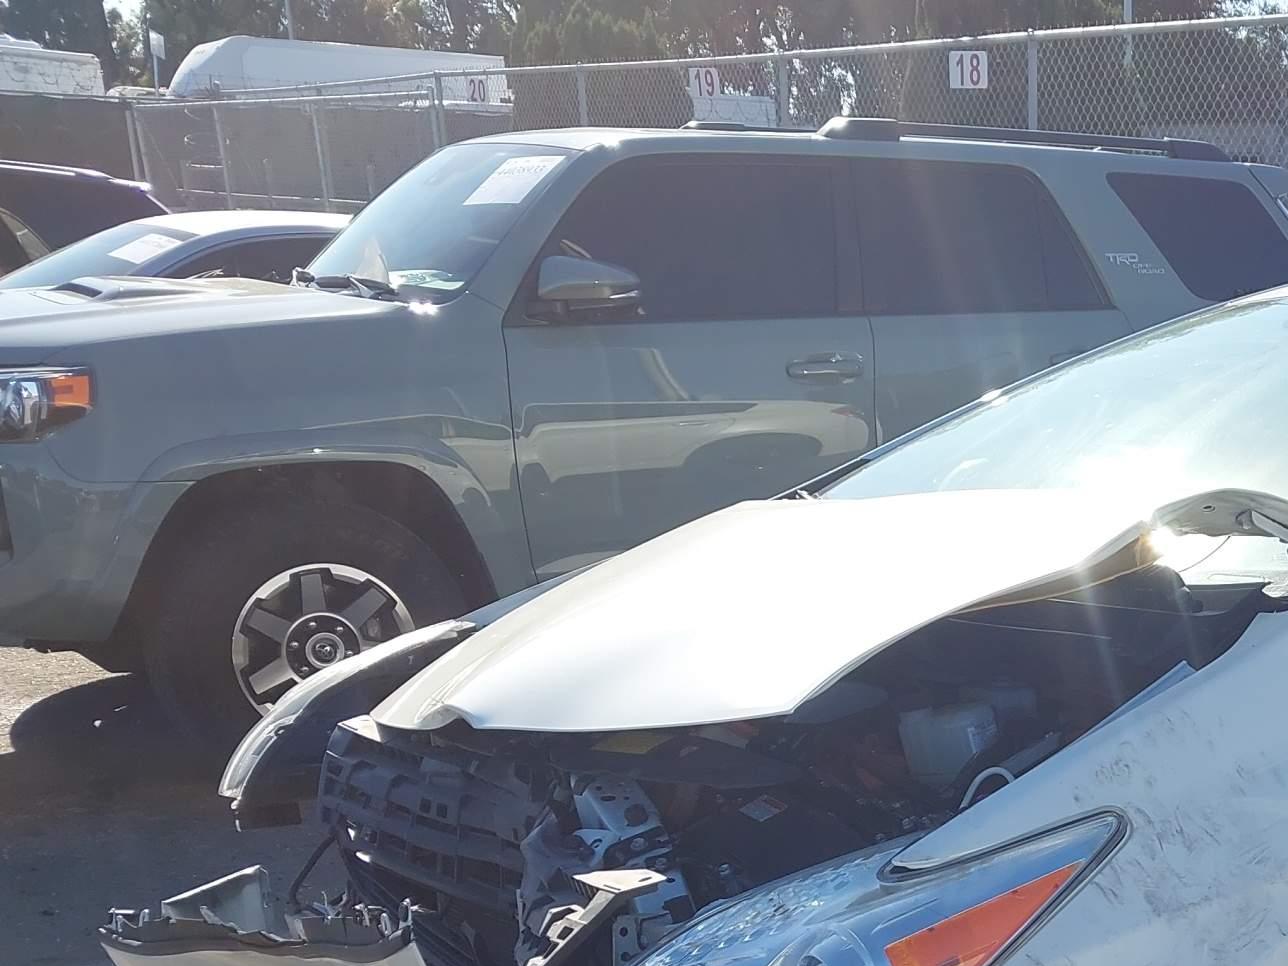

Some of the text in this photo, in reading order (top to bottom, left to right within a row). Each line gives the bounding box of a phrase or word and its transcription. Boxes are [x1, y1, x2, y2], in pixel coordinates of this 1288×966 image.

[694, 68, 716, 97] 19
[956, 53, 981, 86] 18
[468, 78, 486, 101] 20
[1104, 252, 1138, 265] TRD
